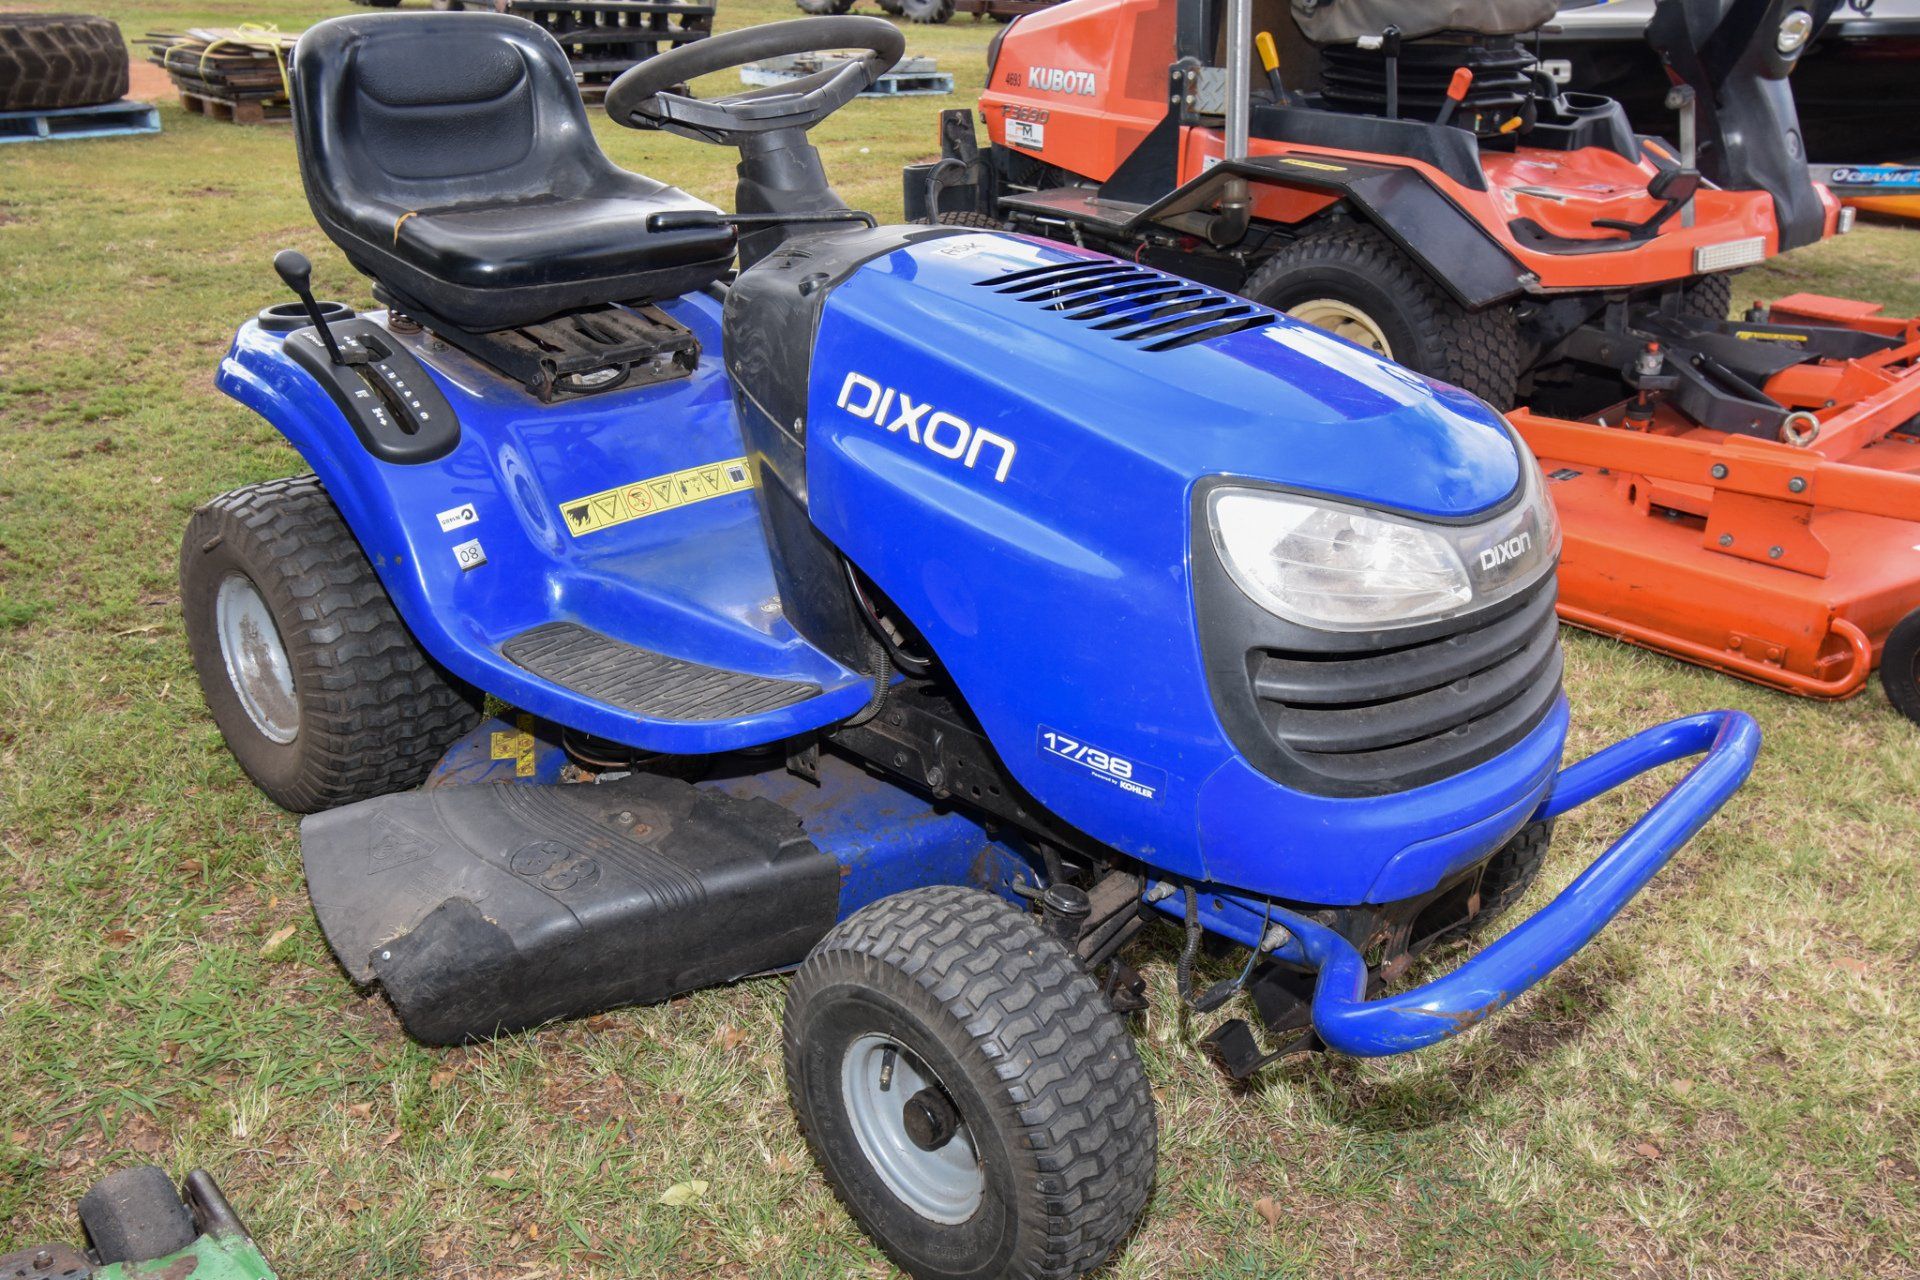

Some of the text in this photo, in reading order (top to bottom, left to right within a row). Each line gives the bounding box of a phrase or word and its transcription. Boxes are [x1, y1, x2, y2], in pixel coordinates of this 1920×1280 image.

[1028, 66, 1096, 96] KUBOTA
[836, 371, 1017, 483] DIXON
[1480, 532, 1531, 571] DIXON
[1044, 732, 1133, 779] 17/38
[1119, 780, 1153, 799] KOHLER
